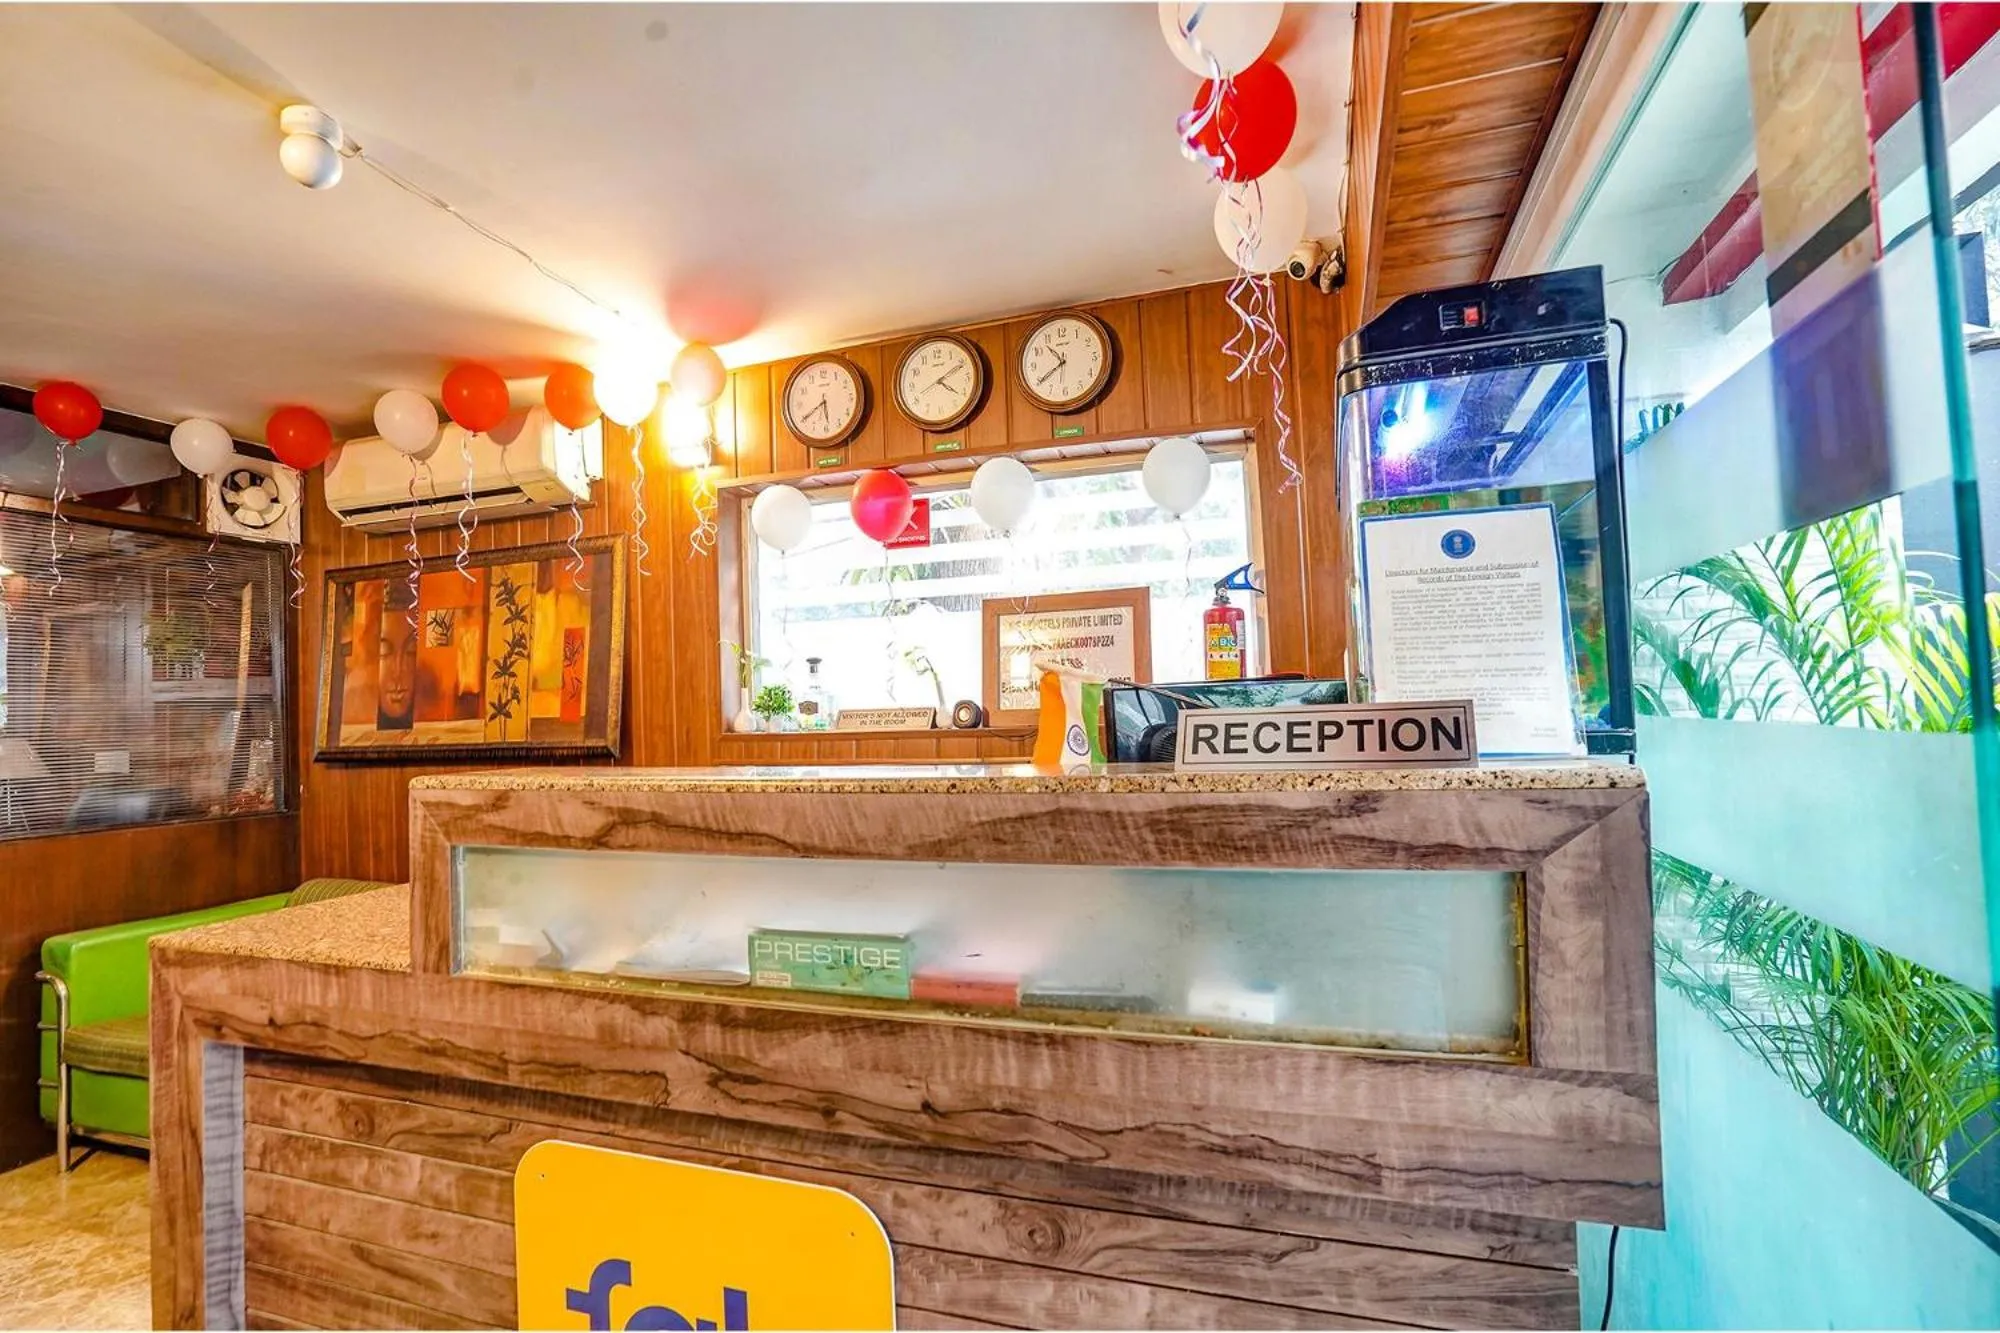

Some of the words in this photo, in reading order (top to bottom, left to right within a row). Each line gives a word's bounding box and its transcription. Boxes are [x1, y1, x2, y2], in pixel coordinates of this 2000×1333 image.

[1058, 327, 1066, 338] 12
[1062, 615, 1091, 629] PRIVATE
[1093, 613, 1123, 627] LIMITED
[1192, 716, 1463, 755] RECEPTION
[754, 940, 902, 970] PRESTIGE
